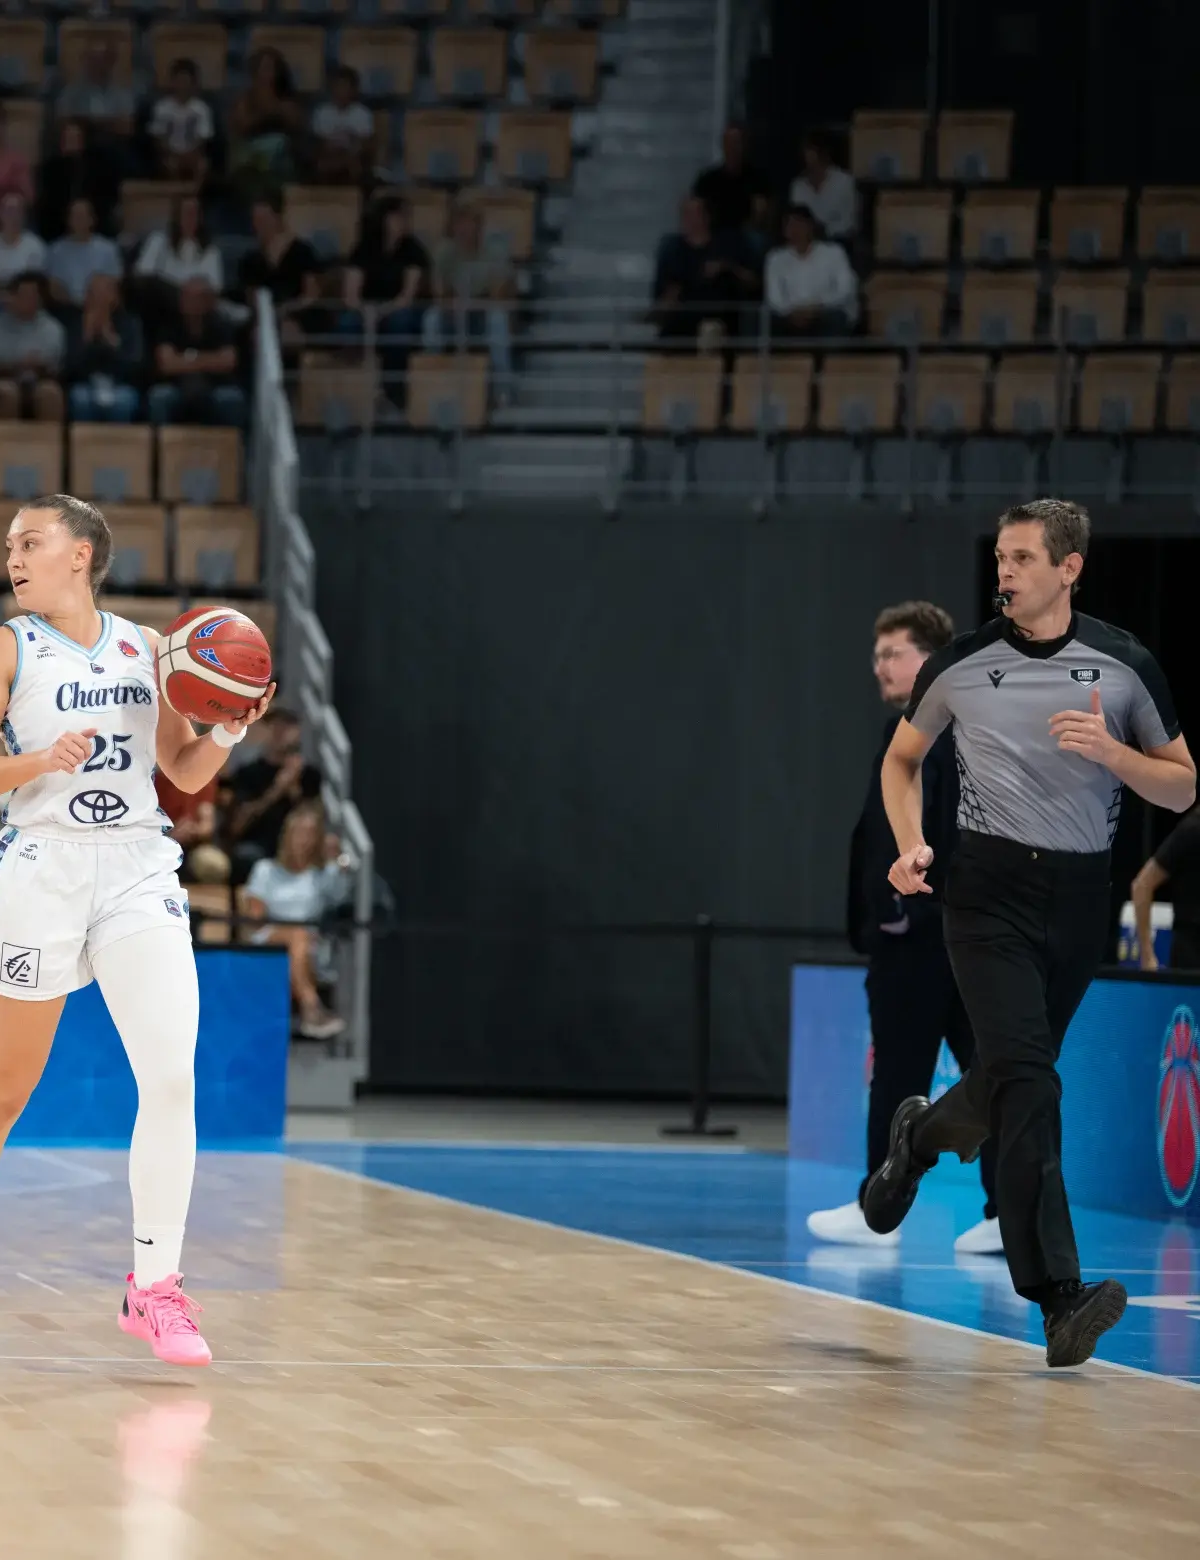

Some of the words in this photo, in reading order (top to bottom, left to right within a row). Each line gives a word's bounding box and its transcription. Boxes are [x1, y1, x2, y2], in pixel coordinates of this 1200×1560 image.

[56, 681, 152, 712] Chartres
[83, 733, 134, 773] 25
[19, 851, 37, 861] SKILLS
